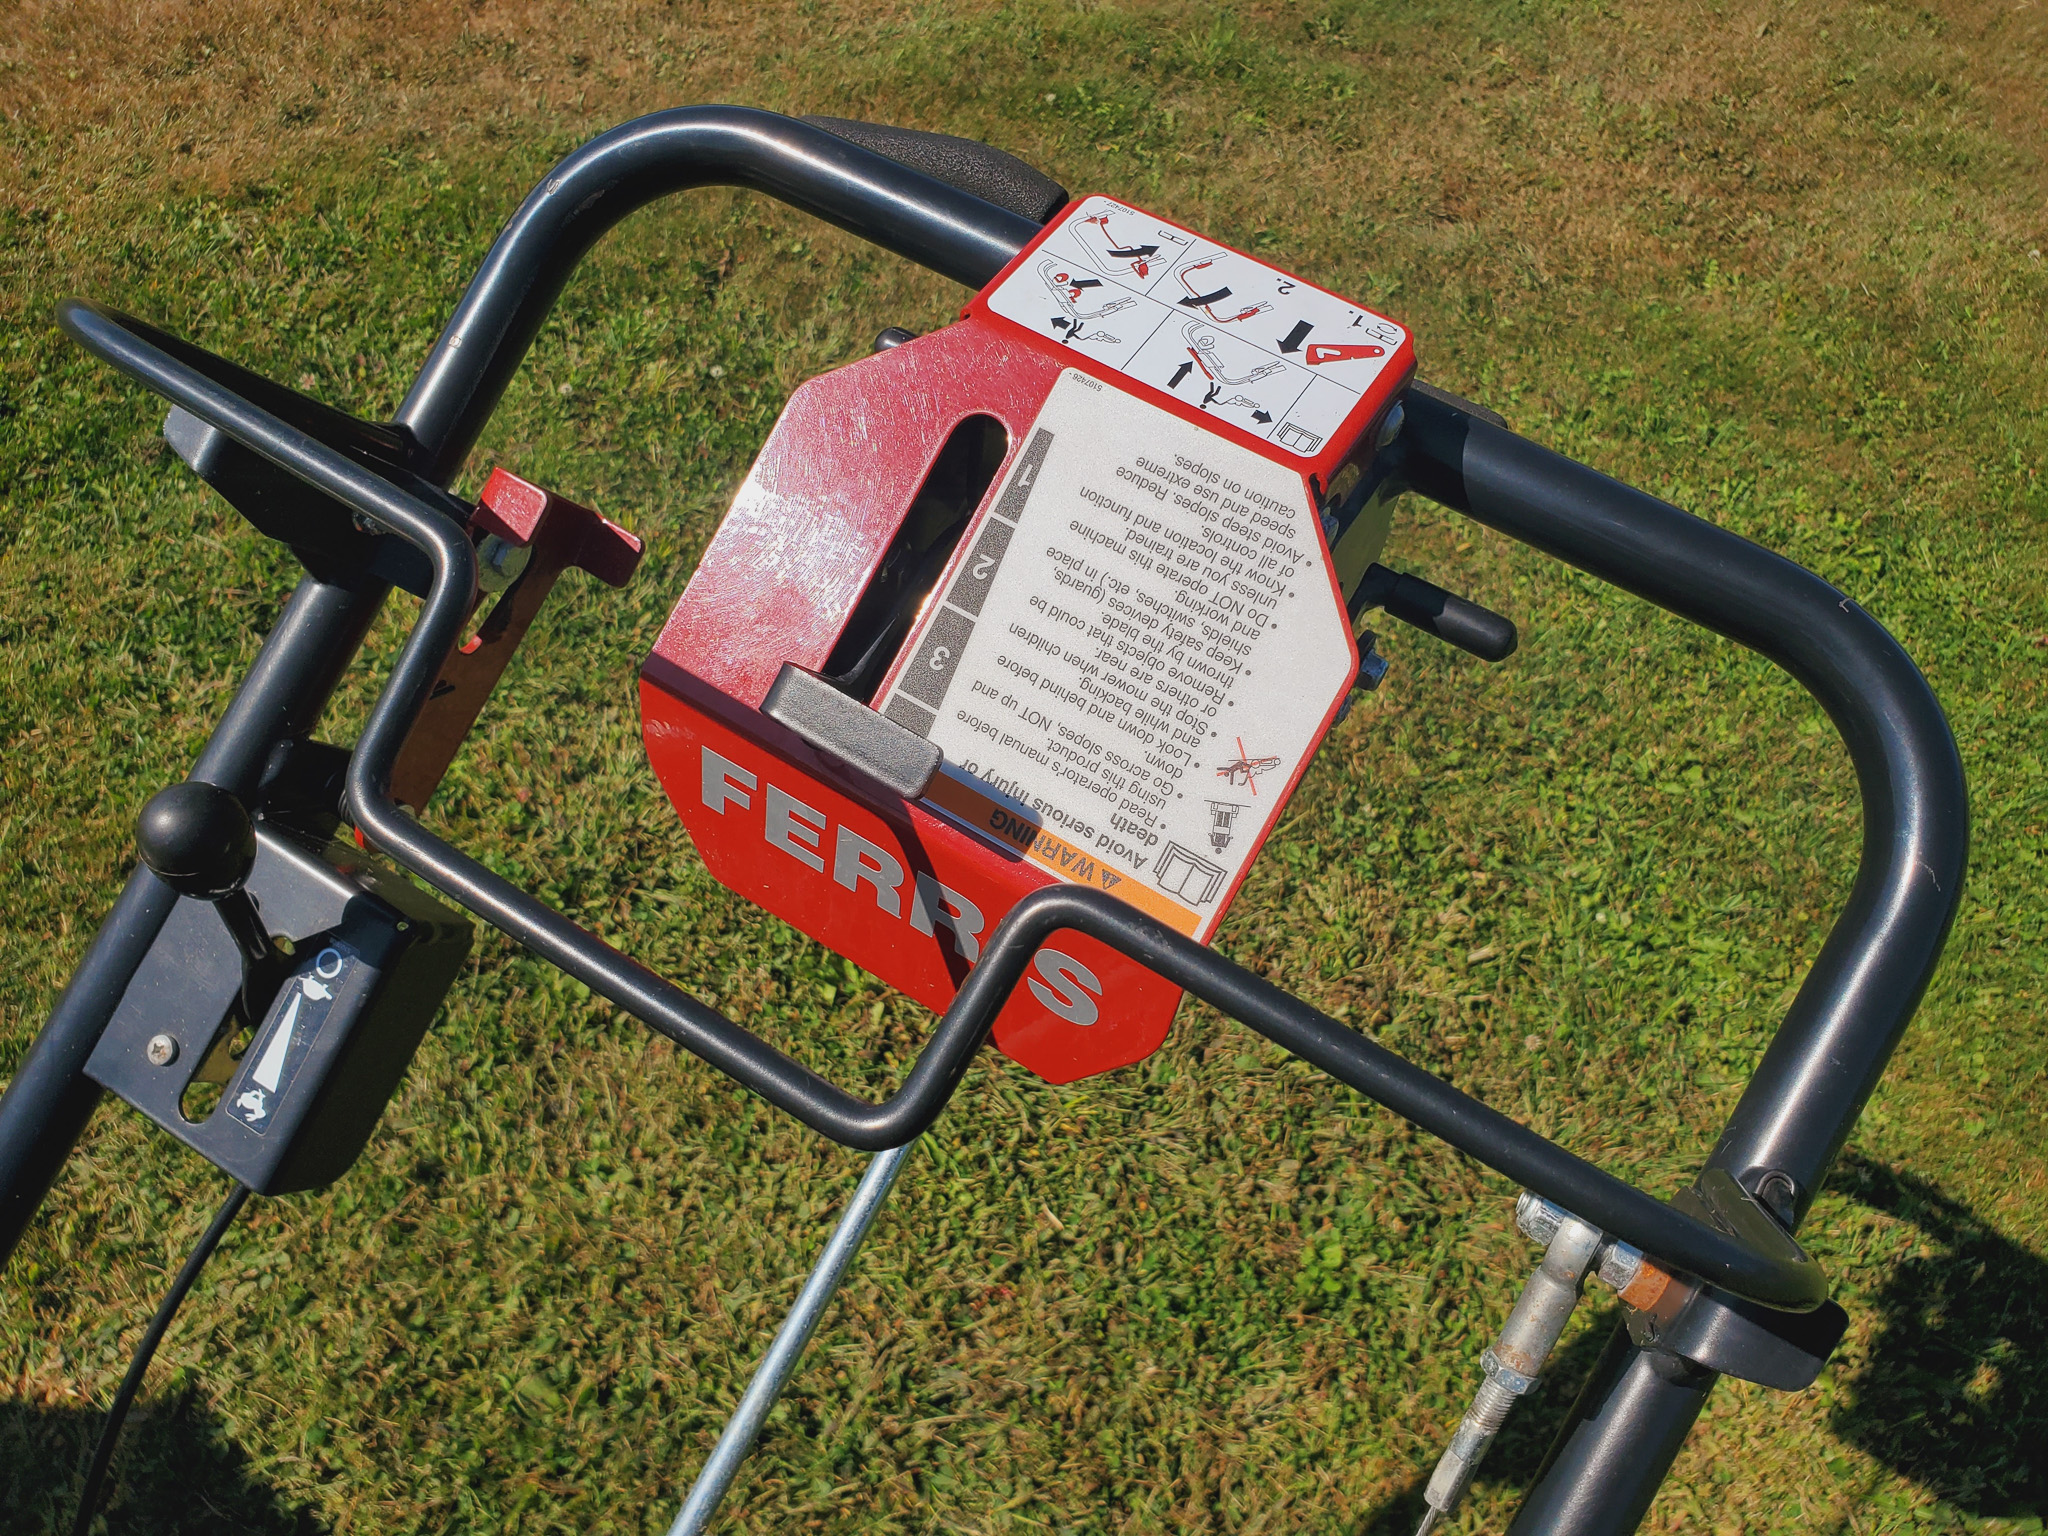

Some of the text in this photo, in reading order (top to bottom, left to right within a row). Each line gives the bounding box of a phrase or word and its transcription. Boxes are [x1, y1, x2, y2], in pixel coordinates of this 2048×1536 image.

[1276, 278, 1296, 295] 2.
[1348, 310, 1364, 328] 1.
[1018, 464, 1034, 487] 1
[1135, 456, 1296, 539] speed and use extreme
[1174, 453, 1296, 519] caution on slopes.
[1079, 486, 1287, 597] Know the location and function
[1115, 466, 1305, 564] Avoid steep slopes. Reduce
[1201, 524, 1295, 578] of all controls.
[972, 554, 996, 580] 2
[1045, 546, 1252, 656] shields, switches, etc.) in place
[1069, 519, 1269, 628] Do NOT operate this machine
[1124, 527, 1278, 610] unless you are trained.
[1029, 595, 1226, 705] Remove objects that could be
[1053, 566, 1243, 675] Keep safety devices (guards,
[1101, 611, 1234, 689] thrown by the blade.
[1174, 589, 1261, 640] and working.
[929, 646, 950, 671] 3
[1008, 622, 1209, 736] Stop the mower when children
[1094, 647, 1217, 717] or others are near.
[970, 679, 1174, 796] Go across slopes, NOT up and
[996, 654, 1192, 767] Look down and behind before
[1078, 676, 1201, 748] and while backing.
[956, 709, 1158, 828] Read operator's manual before
[1046, 737, 1167, 810] using this product.
[1144, 750, 1183, 779] down.
[958, 756, 1148, 870] Avoid serious injury or
[986, 807, 1099, 882] WARNING
[1109, 812, 1159, 847] death
[700, 745, 1103, 1026] FERRS
